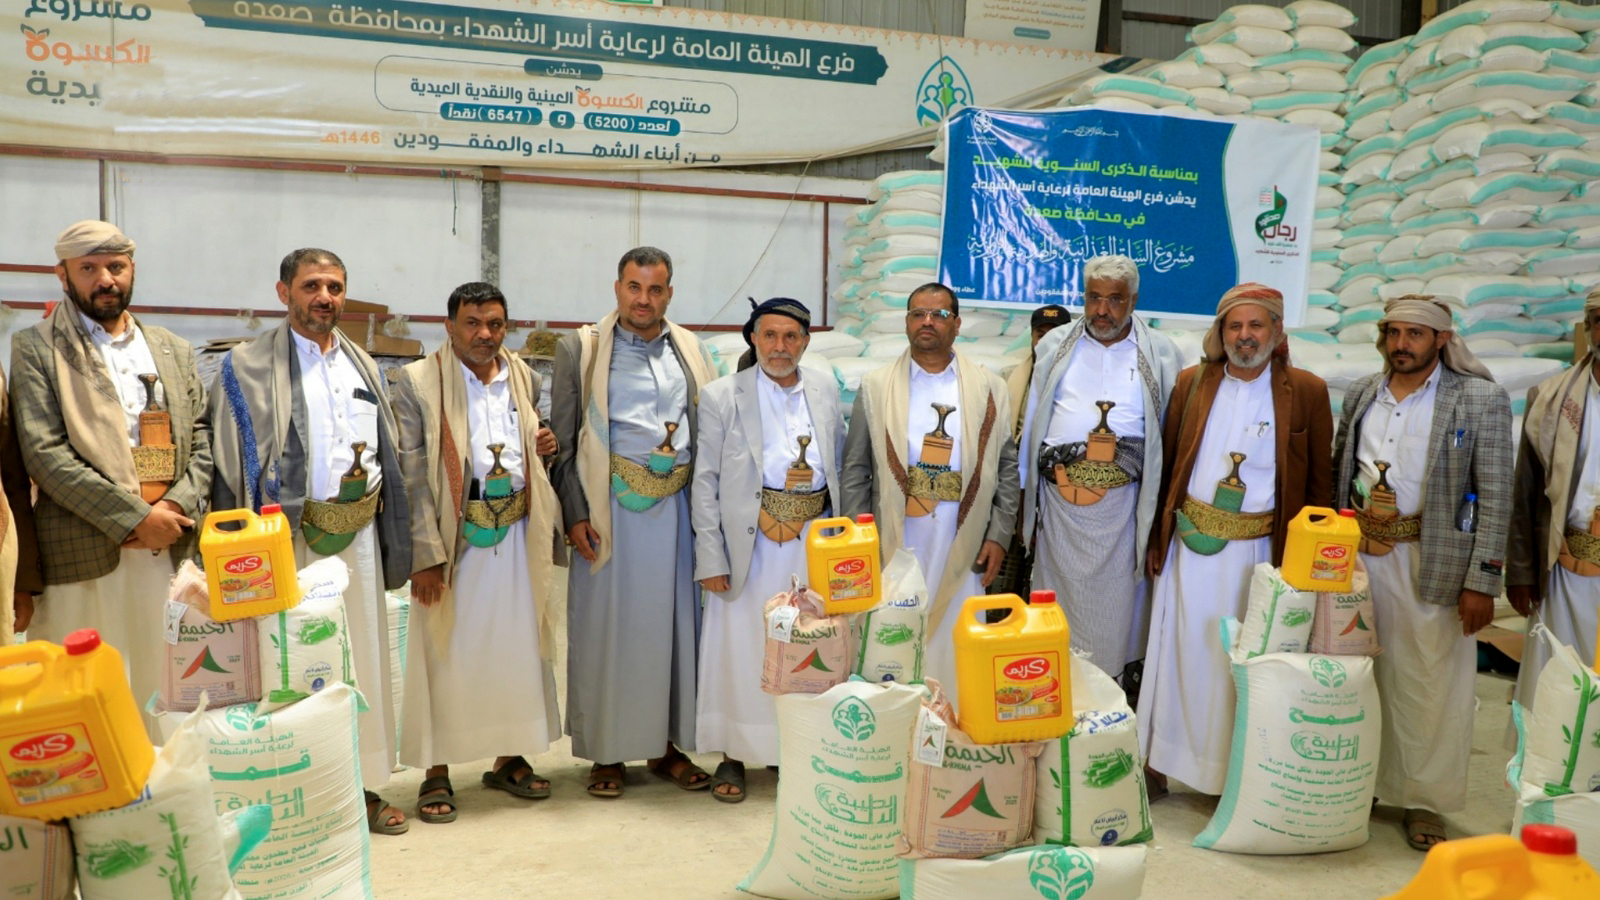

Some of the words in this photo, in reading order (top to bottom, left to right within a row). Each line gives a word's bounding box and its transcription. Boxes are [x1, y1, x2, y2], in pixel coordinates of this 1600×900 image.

[234, 0, 314, 23] صعدة
[329, 5, 446, 41] بمحافظة
[453, 16, 546, 45] الشهداء
[551, 22, 592, 52] أسر
[599, 28, 667, 59] لرعاية
[25, 30, 151, 66] الكسوة
[672, 36, 740, 62] العامة
[747, 43, 811, 72] الهيئة
[546, 64, 582, 79] يدشن
[817, 51, 856, 75] فرع
[410, 78, 460, 97] العيدية
[465, 82, 523, 103] والنقدية
[528, 86, 574, 107] العينية
[576, 89, 644, 110] الكسوة
[646, 96, 712, 116] مشروع
[556, 112, 567, 127] و
[638, 119, 671, 133] لعدد
[394, 131, 533, 155] والمفقودين
[537, 138, 640, 161] الشهداء
[644, 142, 681, 163] أبناء
[683, 152, 721, 165] من
[973, 153, 1033, 169] للشهيد
[1035, 156, 1101, 174] السنوية
[1102, 162, 1147, 178] الذكرى
[1150, 163, 1199, 185] بمناسبة
[971, 177, 1014, 192] الشهداء
[1015, 179, 1036, 195] أسر
[1037, 181, 1071, 197] لرعاية
[1073, 184, 1108, 198] العامة
[1110, 186, 1142, 201] الهيئة
[1143, 189, 1164, 206] فرع
[1165, 192, 1197, 208] يدشن
[1026, 204, 1062, 219] صعدة
[1065, 205, 1121, 223] محافظة
[1123, 212, 1146, 229] في
[1263, 222, 1297, 242] رجال
[1153, 240, 1195, 273] مشروع
[226, 556, 259, 573] كريم
[835, 560, 862, 573] كريم
[179, 620, 234, 635] الخيمة
[1007, 659, 1045, 679] كريم
[1289, 704, 1365, 725] قمح
[15, 733, 67, 759] كريم
[944, 740, 1015, 765] الخيمة
[810, 753, 903, 783] قمح
[942, 760, 972, 772] L-KHIMA
